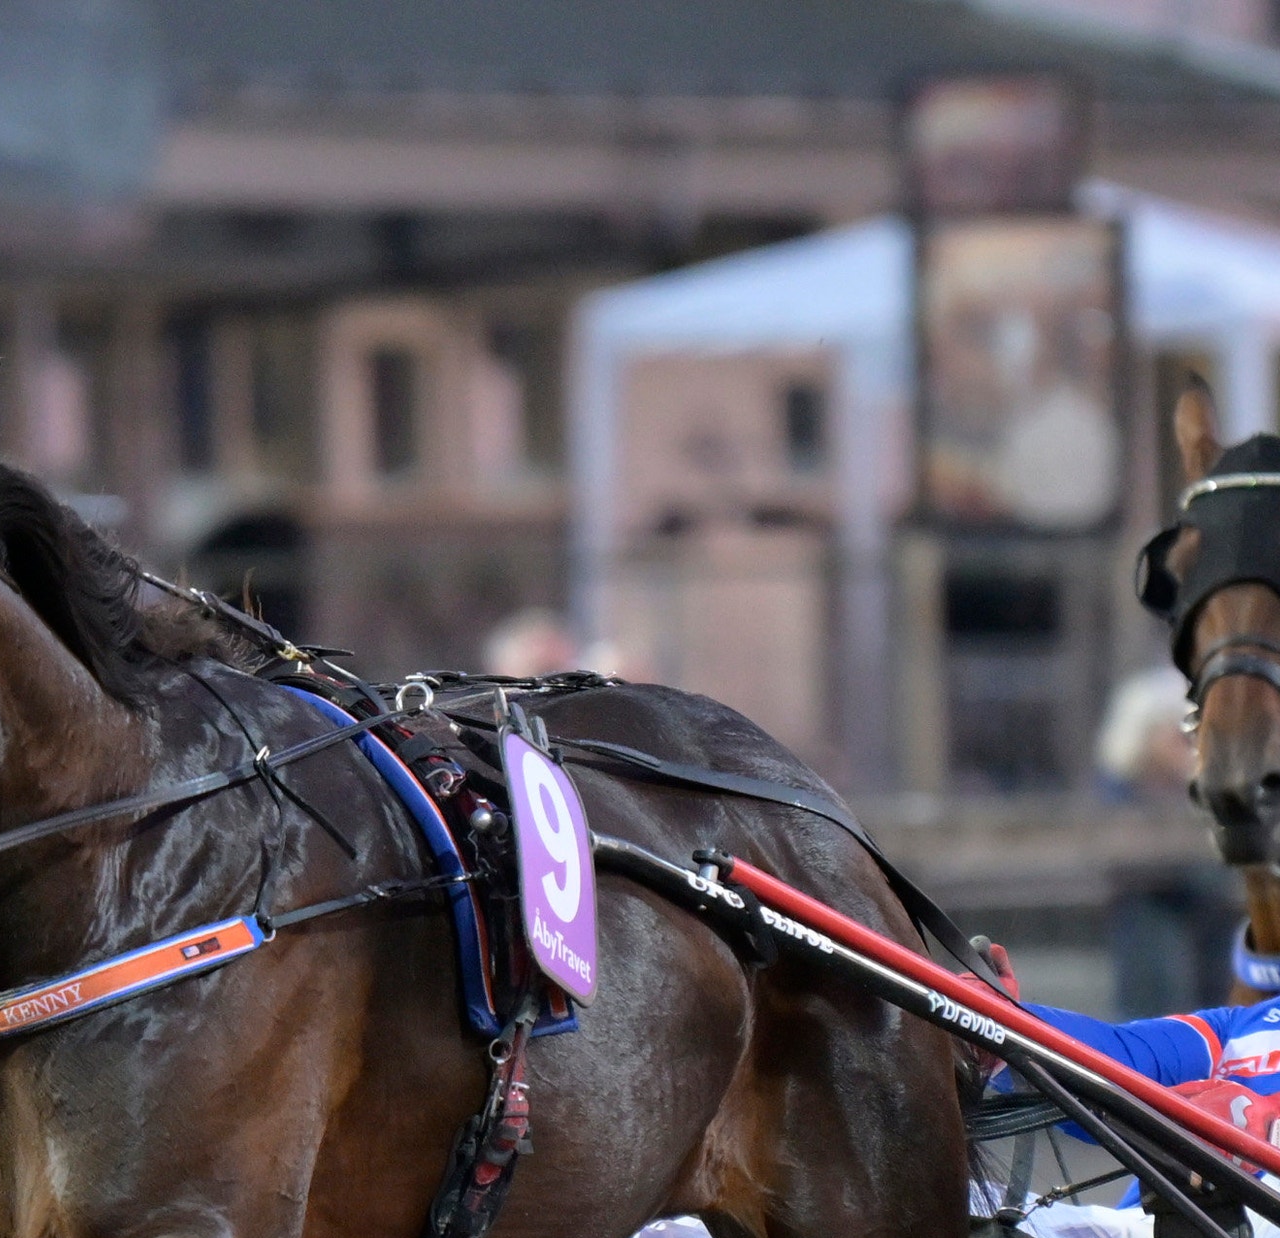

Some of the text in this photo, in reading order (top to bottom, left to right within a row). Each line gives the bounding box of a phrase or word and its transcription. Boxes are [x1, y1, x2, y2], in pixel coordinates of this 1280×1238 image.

[523, 752, 580, 923] 9
[533, 907, 591, 984] ÅbyTravet
[3, 982, 83, 1025] KENNY
[942, 995, 1006, 1045] bravida
